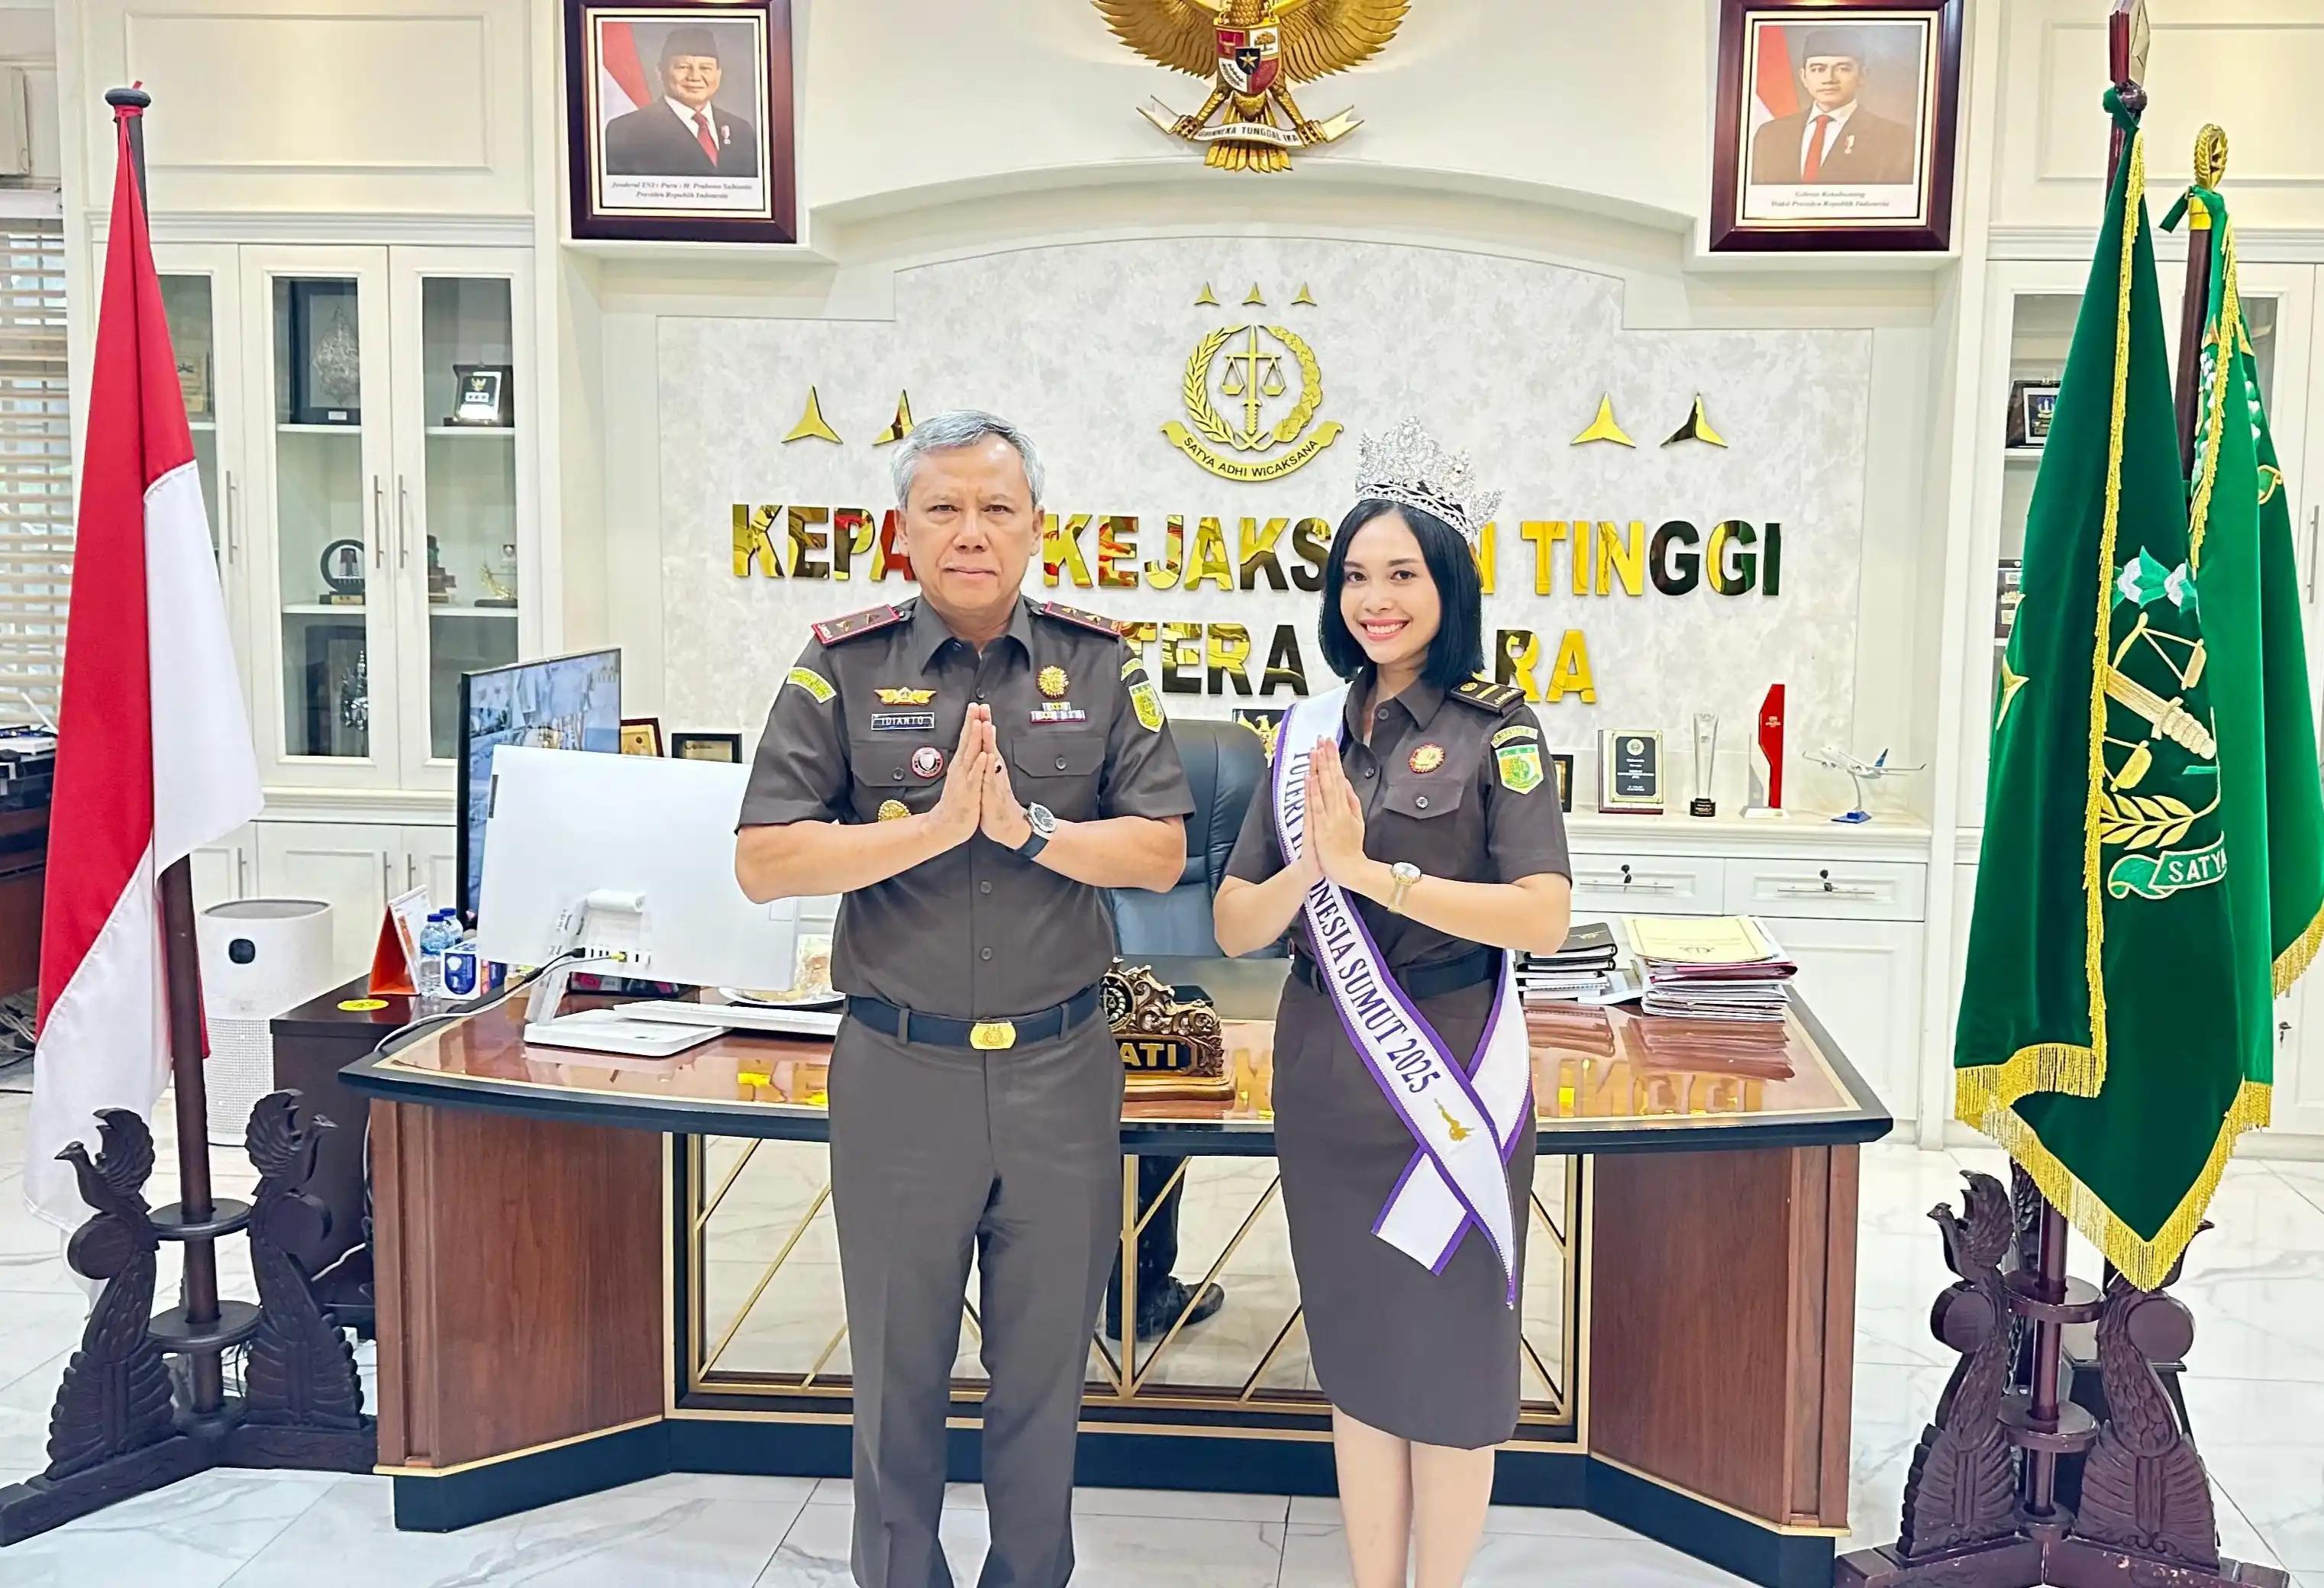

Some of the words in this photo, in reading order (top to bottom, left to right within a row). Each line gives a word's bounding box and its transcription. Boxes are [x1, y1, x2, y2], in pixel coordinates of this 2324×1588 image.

[1183, 437, 1214, 468] SATYA
[1218, 463, 1247, 476] ADHI
[1251, 441, 1319, 477] WICAKSANA
[733, 504, 918, 581] KEPA
[1043, 514, 1496, 595] KEJAKSN
[1521, 520, 1782, 596] TINGGI
[1338, 958, 1408, 1044] SUMUT
[1386, 1038, 1441, 1093] 2025
